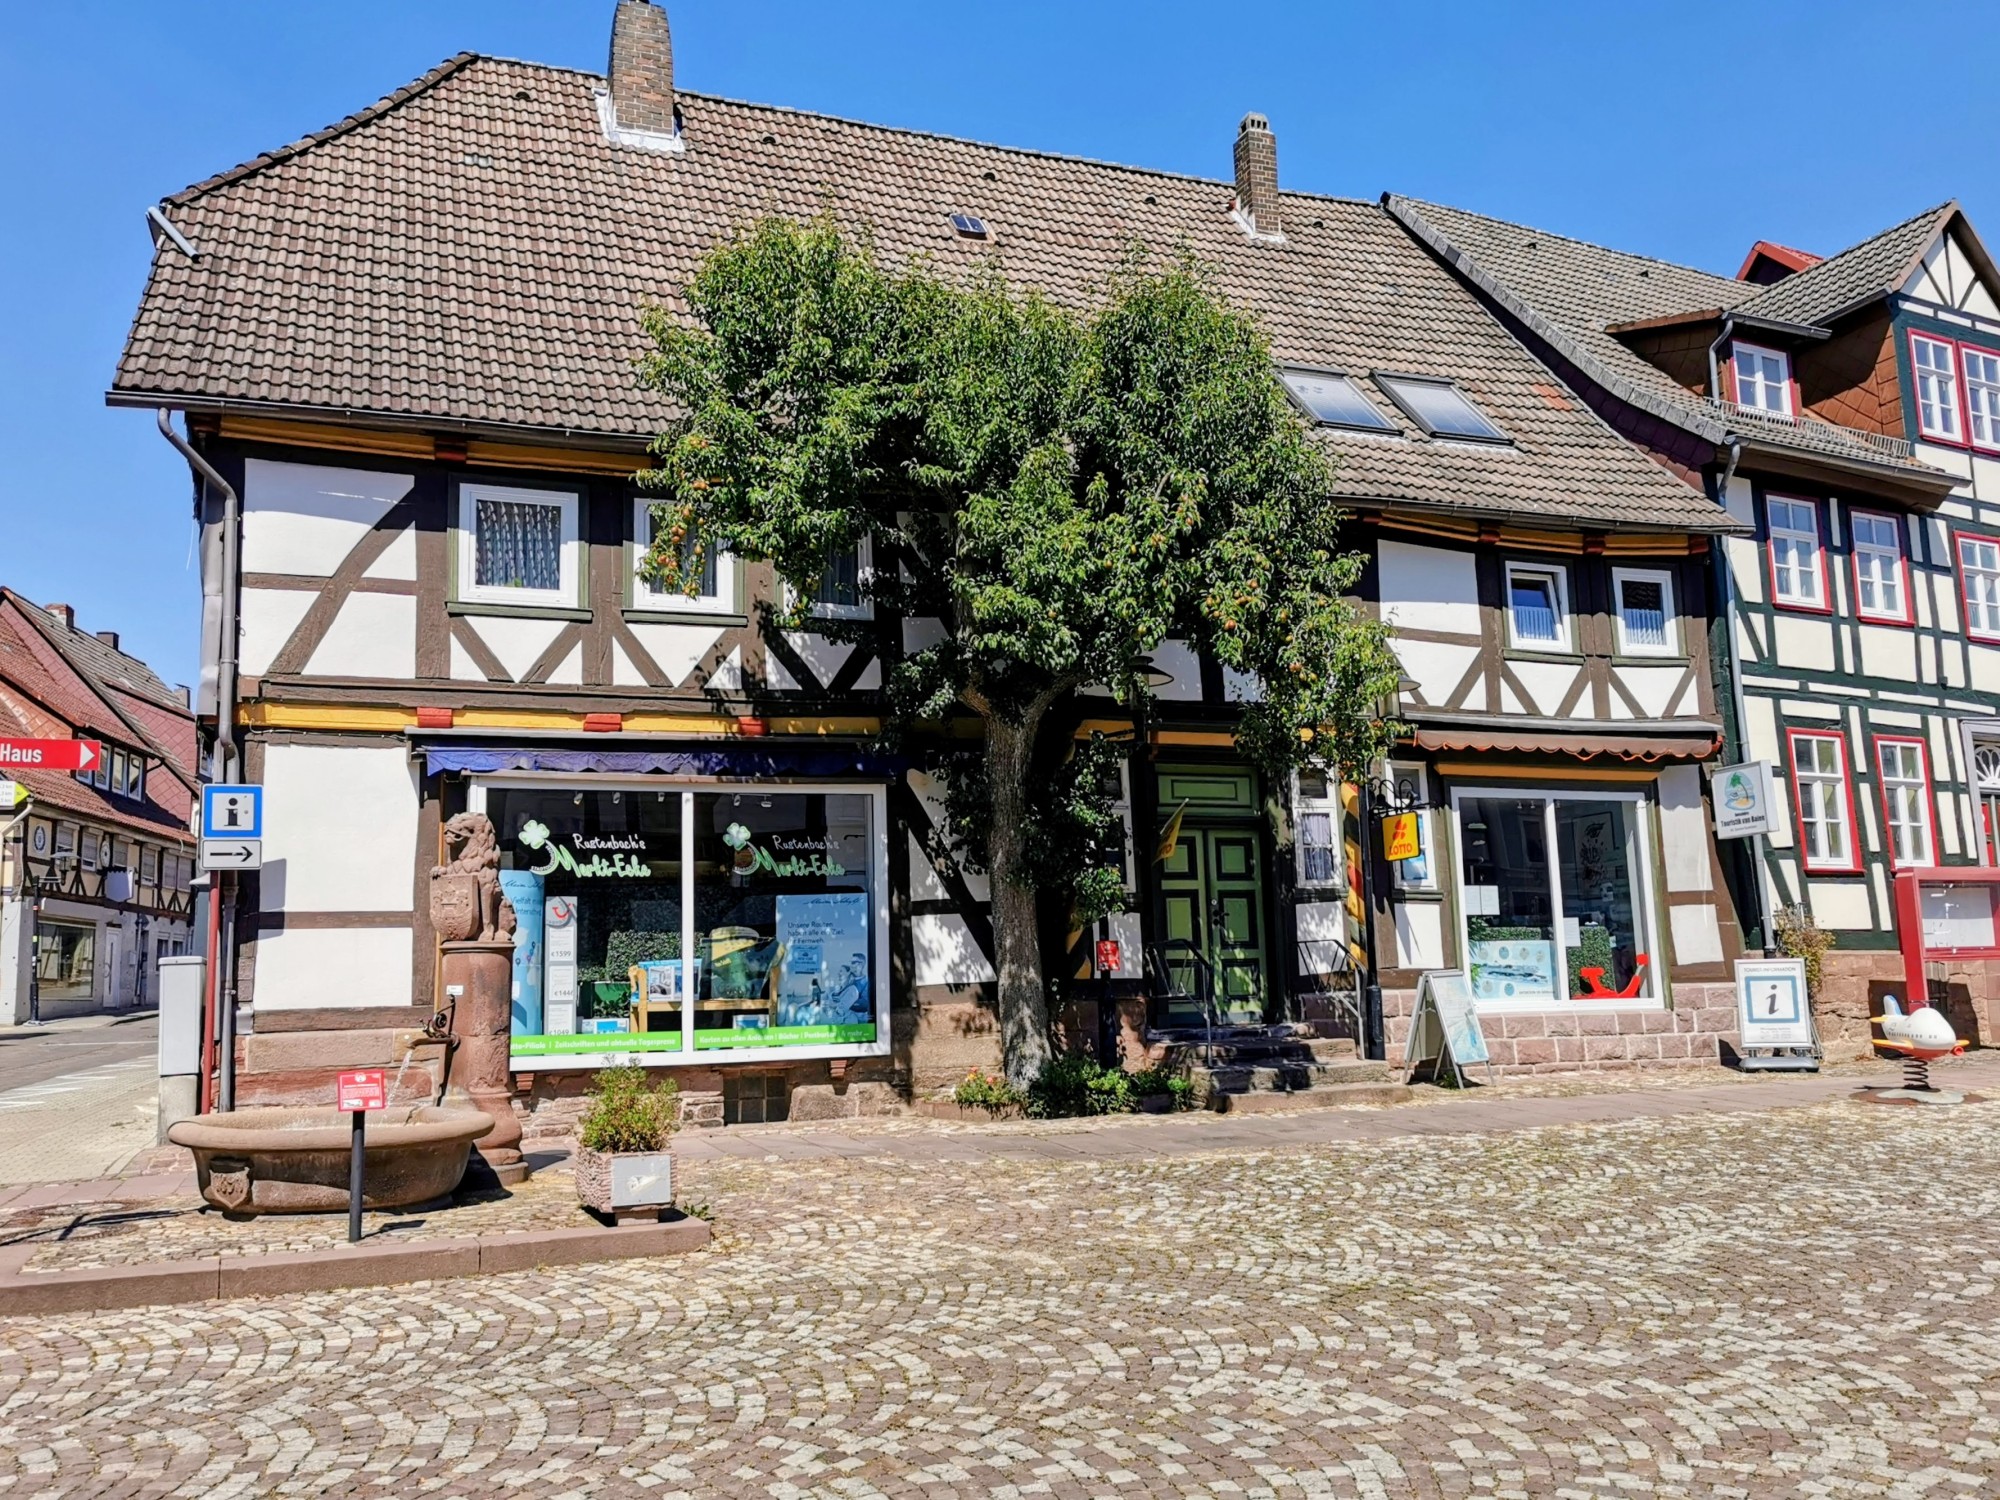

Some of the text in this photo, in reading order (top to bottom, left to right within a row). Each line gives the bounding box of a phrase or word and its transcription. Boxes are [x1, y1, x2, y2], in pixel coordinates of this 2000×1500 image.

[0, 743, 43, 763] Haus
[1720, 818, 1742, 828] Touristik
[572, 833, 646, 850] Rustenbach's
[772, 834, 840, 850] Rustenbach's
[1388, 842, 1413, 856] LOTTO
[549, 843, 652, 879] Markt-Ecke
[750, 845, 846, 878] Markt-Ecke
[511, 1037, 676, 1050] tto-Filiale Zeitschriften und aktuelle Tagespresse
[699, 1036, 721, 1044] Karten
[730, 1033, 747, 1042] allen
[778, 1031, 800, 1041] Bücher
